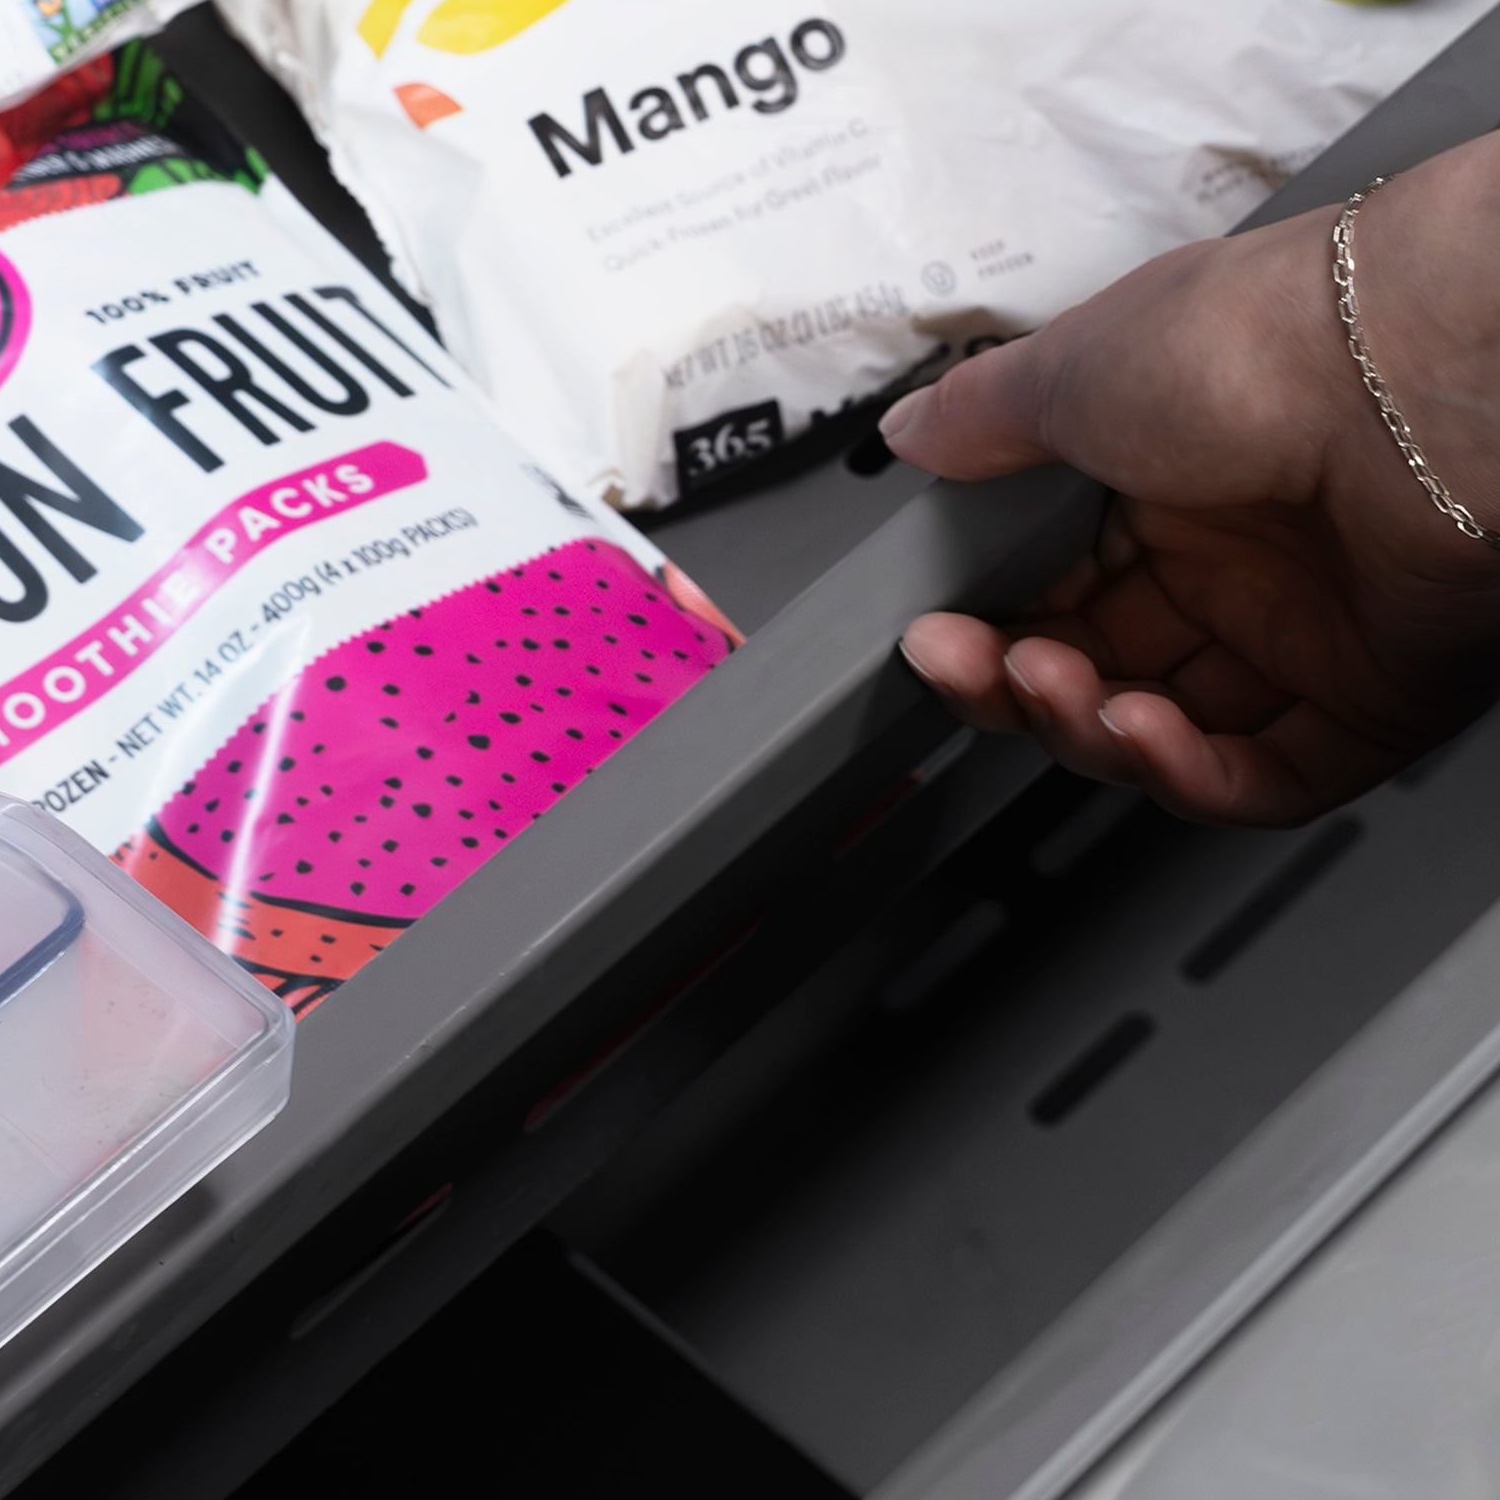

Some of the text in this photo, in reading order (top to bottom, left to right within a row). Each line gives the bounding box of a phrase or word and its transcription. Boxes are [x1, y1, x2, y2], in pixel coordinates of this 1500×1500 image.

[527, 17, 846, 178] Mango
[84, 260, 261, 325] 100% FRUIT
[90, 285, 455, 473] FRUIT
[204, 464, 375, 563] PACKS
[688, 419, 772, 478] 365
[31, 760, 110, 812] OZEN
[116, 712, 162, 758] NET
[157, 683, 204, 718] WT.
[193, 660, 222, 685] 14
[218, 630, 254, 664] OZ
[261, 575, 323, 623] 400g
[314, 560, 343, 586] (4
[351, 538, 411, 568] 100g
[400, 507, 478, 547] PACKS)
